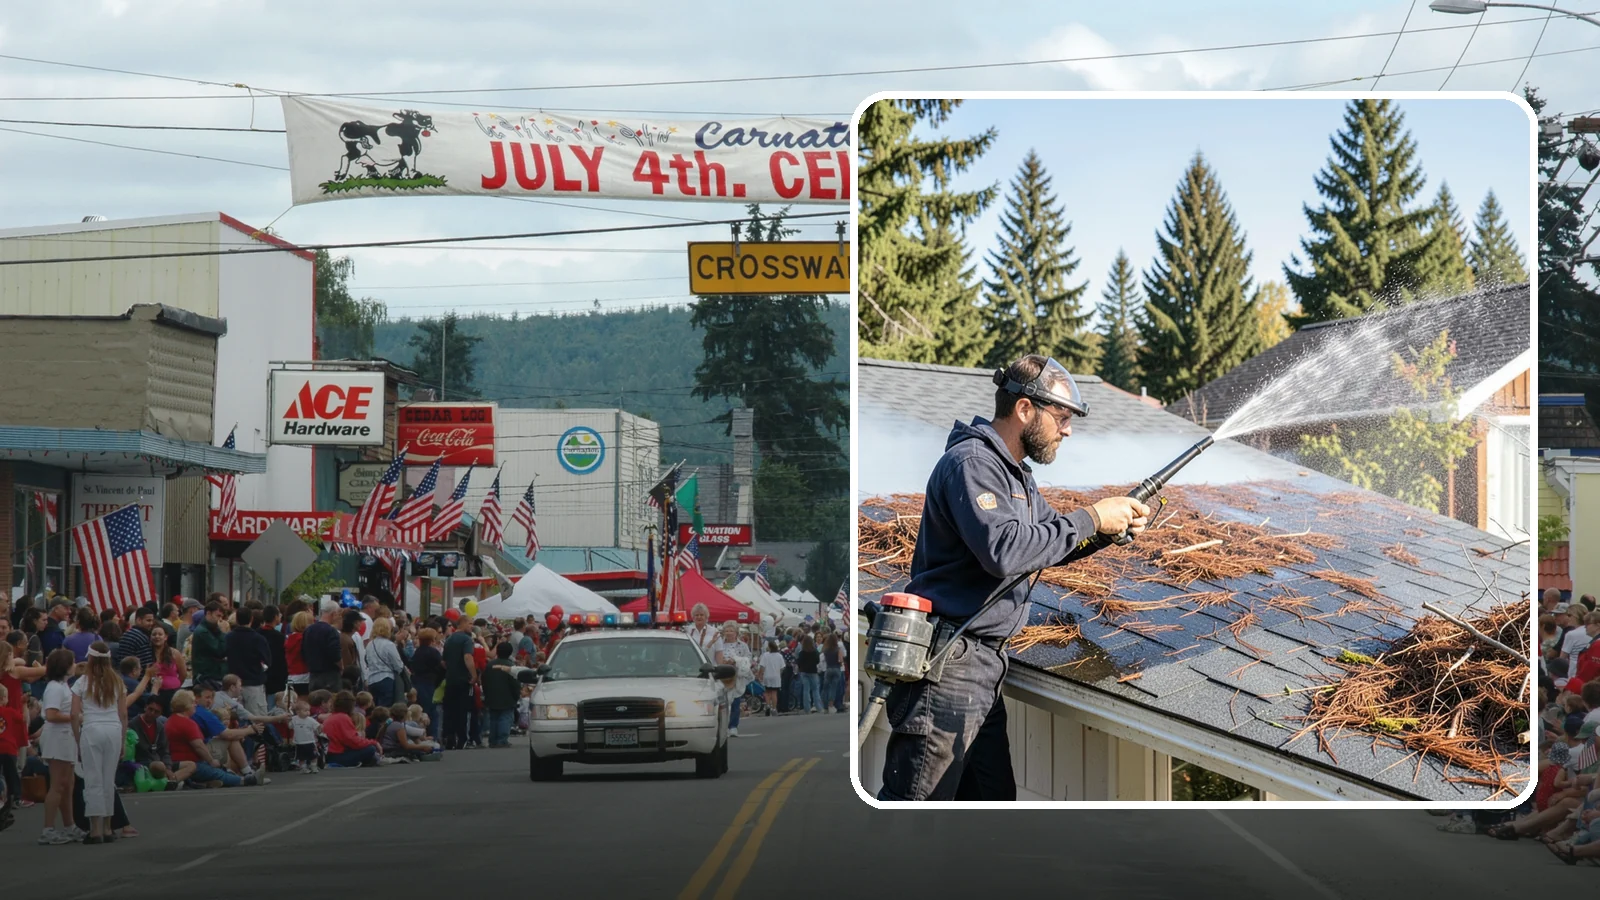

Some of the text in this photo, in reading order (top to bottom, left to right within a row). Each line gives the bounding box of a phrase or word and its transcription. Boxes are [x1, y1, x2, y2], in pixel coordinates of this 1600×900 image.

[695, 121, 850, 150] Carnat
[481, 140, 605, 192] JULY
[632, 149, 746, 198] 4th.
[697, 254, 850, 280] CROSSWA
[282, 379, 373, 420] ACE
[405, 409, 485, 422] CEDAR LOG
[283, 420, 371, 437] Hardware
[416, 428, 477, 447] Coca-Cola
[353, 466, 385, 481] Simpl
[83, 484, 155, 496] St. Vincent de Paul
[80, 502, 154, 522] THT
[212, 515, 331, 536] HARDARE
[688, 526, 742, 535] CRNATION
[699, 535, 730, 544] GLASS
